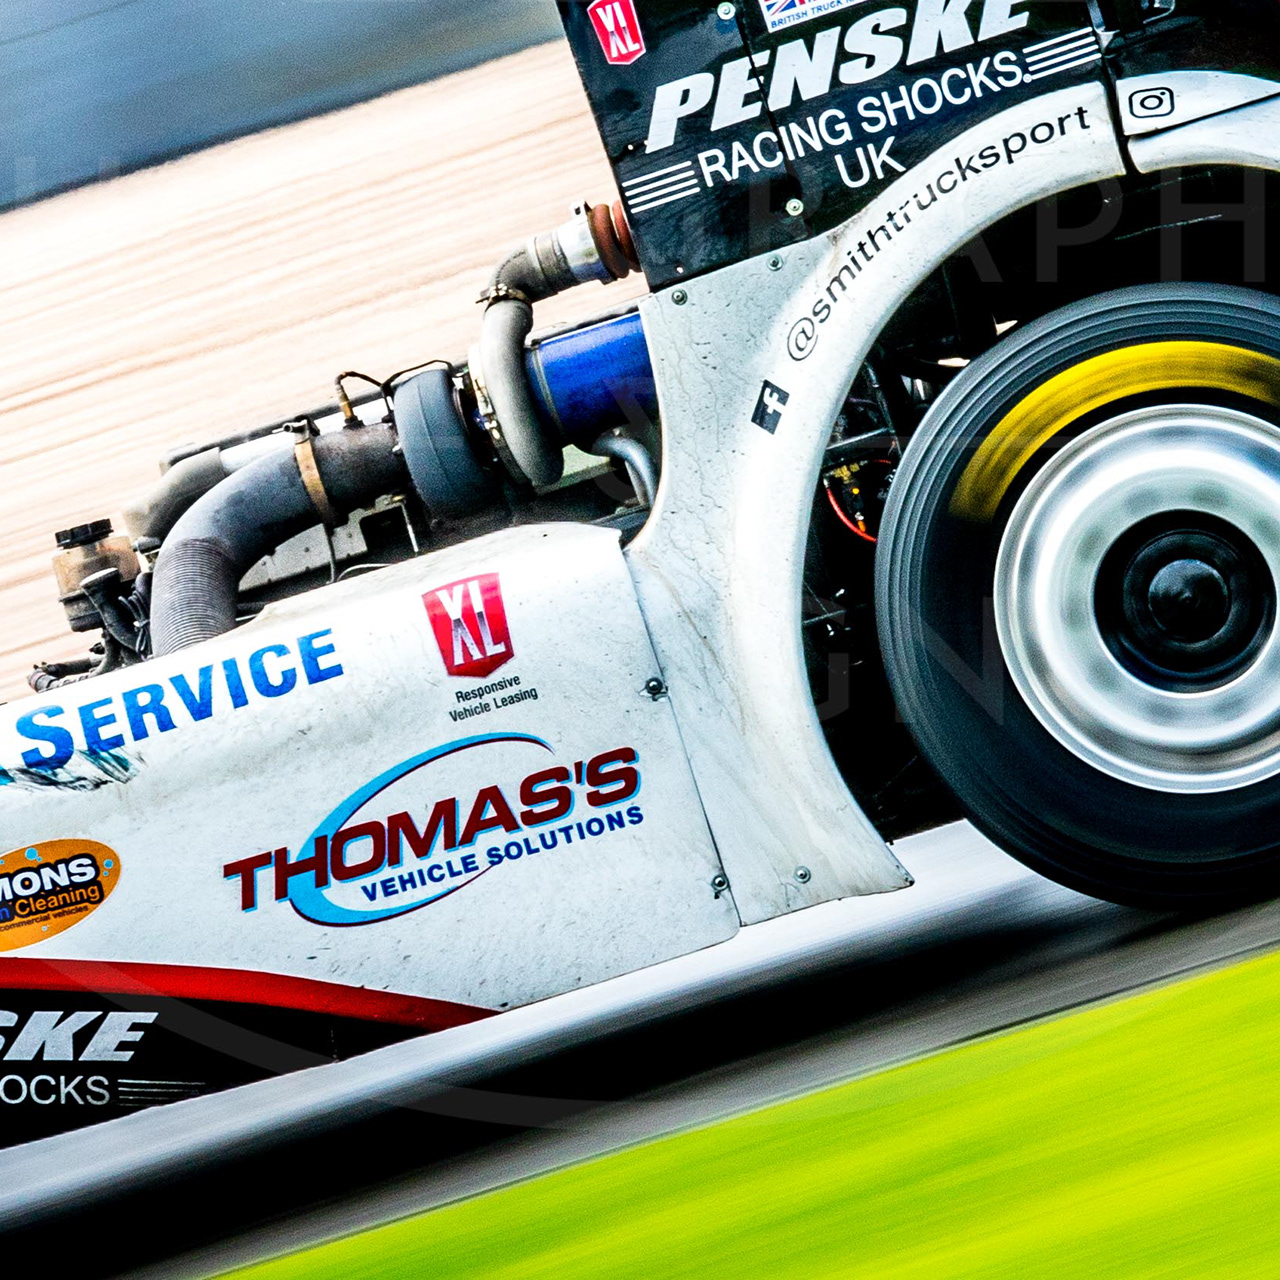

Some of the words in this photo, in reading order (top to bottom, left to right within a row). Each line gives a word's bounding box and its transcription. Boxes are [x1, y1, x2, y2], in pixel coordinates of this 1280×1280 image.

[595, 1, 640, 58] XL
[771, 10, 808, 28] BRITISH
[696, 108, 853, 189] RACING
[857, 51, 1023, 132] SHOCKS
[833, 136, 907, 189] UK
[786, 106, 1091, 362] @smithtrucksport
[434, 579, 506, 667] XL
[448, 696, 492, 722] Vehicle
[494, 686, 539, 712] Leasing
[455, 675, 522, 704] Responsive
[222, 747, 641, 912] THOMAS'S
[361, 854, 480, 902] VEHICLE
[487, 806, 644, 868] SOLUTIONS
[0, 914, 51, 932] commercial
[52, 904, 89, 920] vehicles
[15, 885, 100, 915] Cleaning
